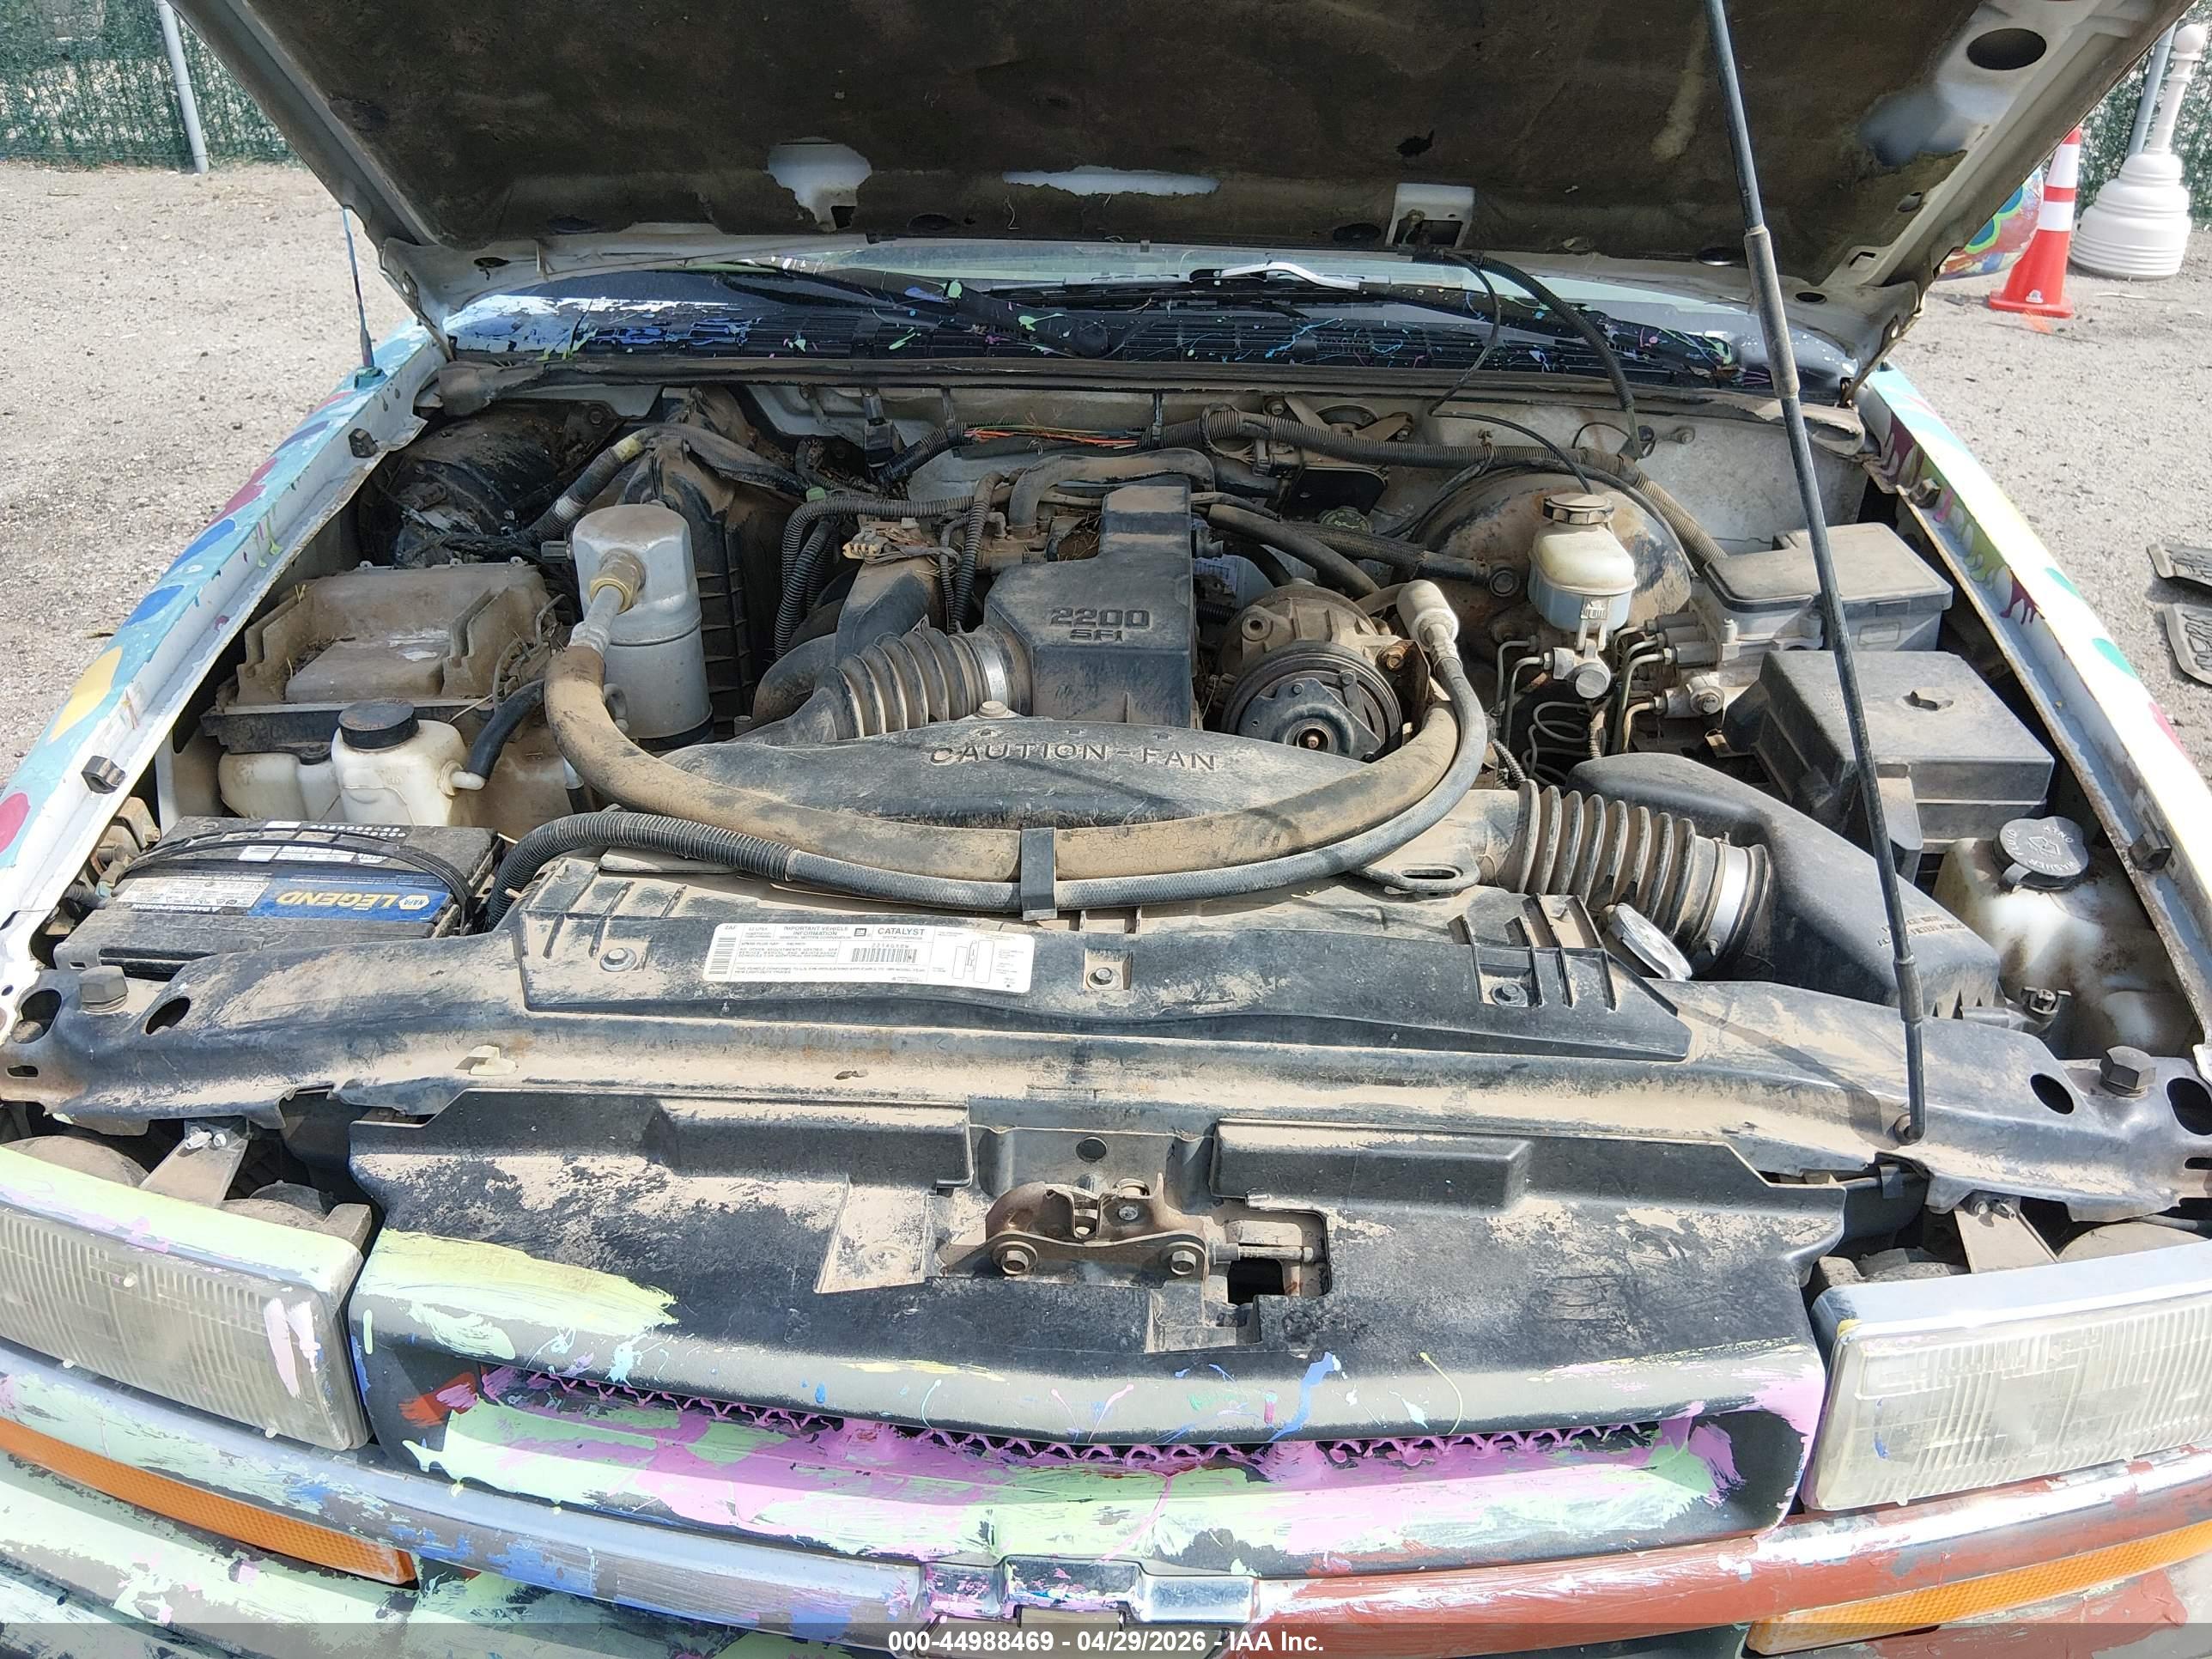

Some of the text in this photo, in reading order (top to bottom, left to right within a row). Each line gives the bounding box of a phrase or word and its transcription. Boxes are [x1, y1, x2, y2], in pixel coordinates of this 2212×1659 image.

[1050, 607, 1151, 629] 2200
[1070, 629, 1124, 641] SFI
[275, 892, 399, 908] LEGEND
